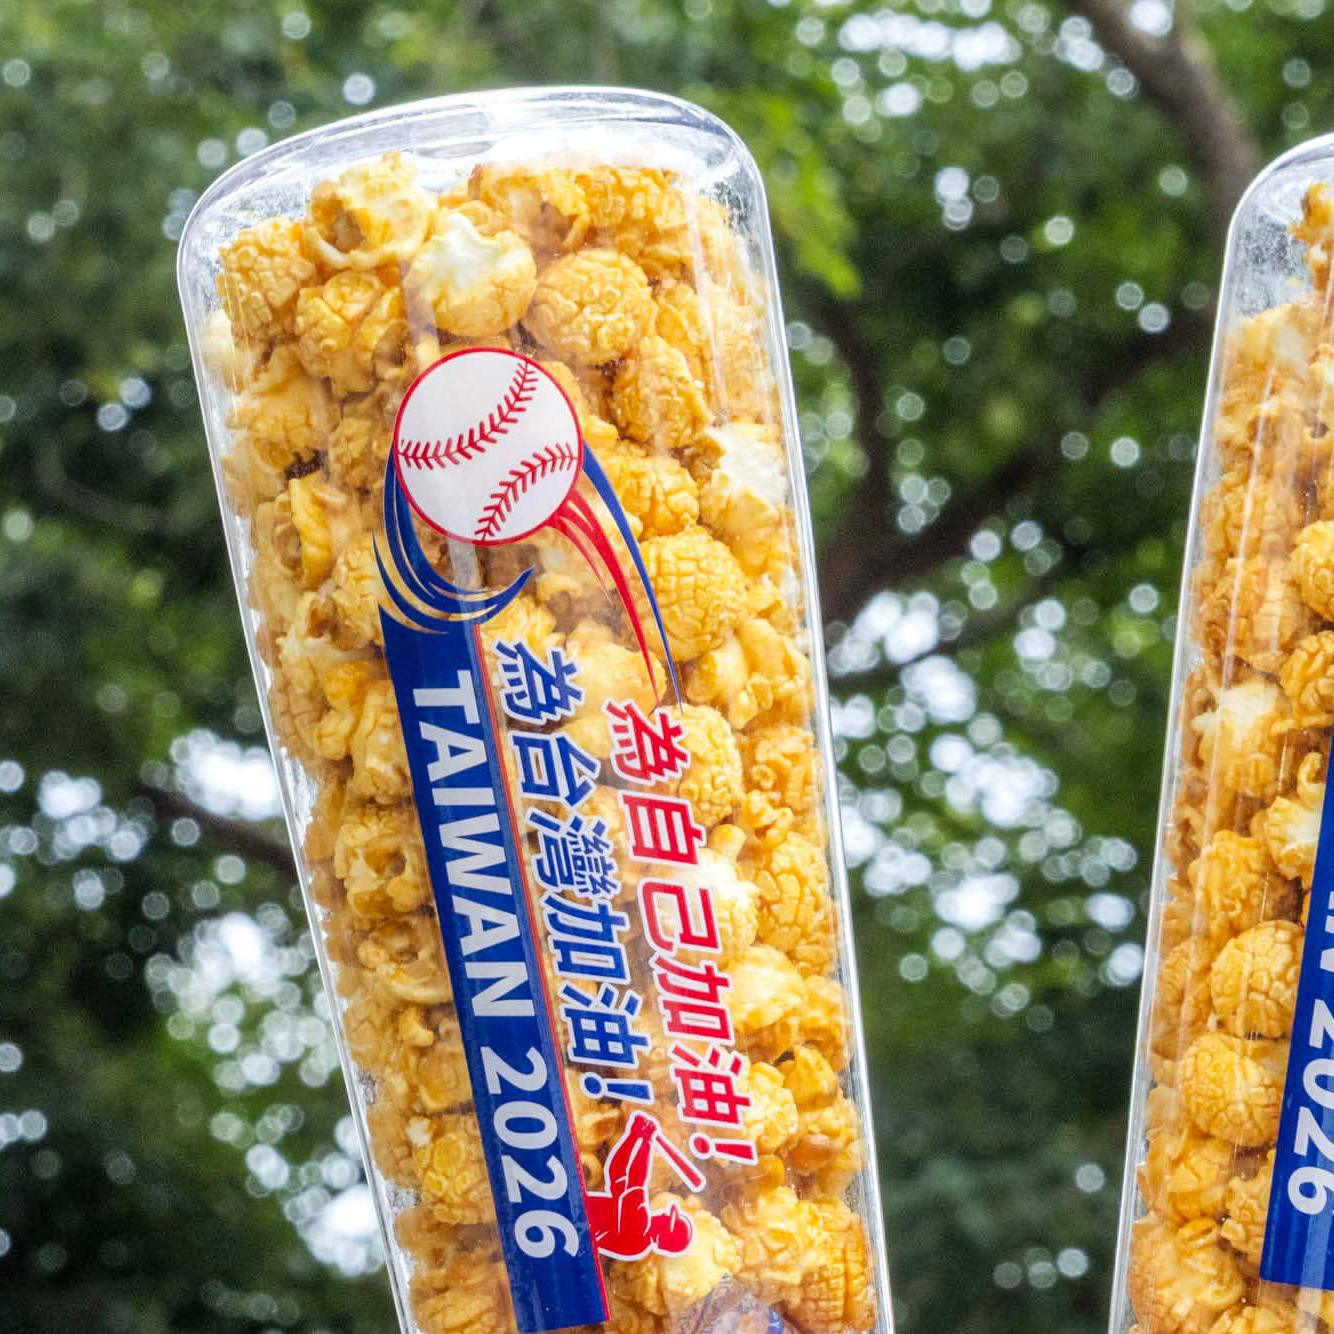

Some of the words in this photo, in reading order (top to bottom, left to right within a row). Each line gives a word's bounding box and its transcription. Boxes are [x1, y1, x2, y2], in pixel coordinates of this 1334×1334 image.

[413, 667, 536, 1018] TAIWAN
[480, 1046, 581, 1258] 2026
[494, 639, 653, 1105] 為台灣加油!
[605, 701, 755, 1163] 為自己加油!
